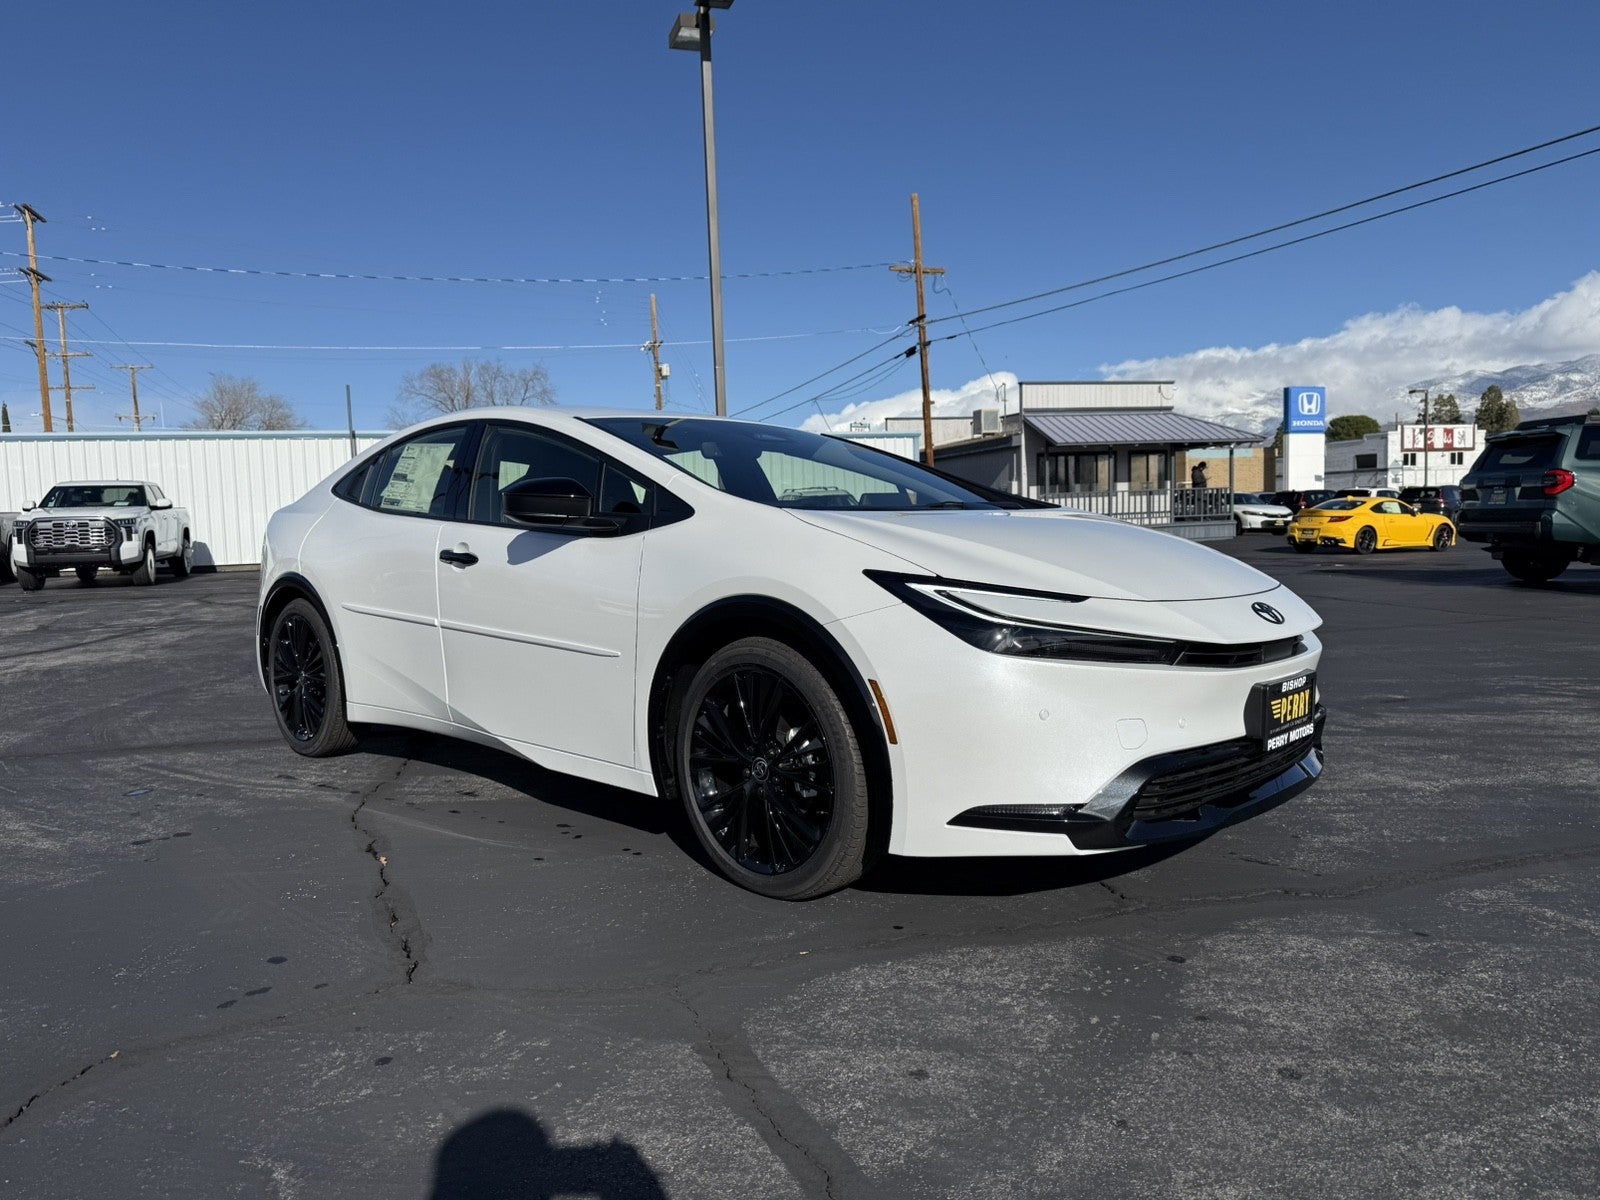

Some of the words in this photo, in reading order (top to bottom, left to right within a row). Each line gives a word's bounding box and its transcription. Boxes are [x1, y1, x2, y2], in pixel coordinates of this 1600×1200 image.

[1281, 676, 1307, 692] BISHOP
[1280, 689, 1310, 724] PERRY
[1267, 733, 1289, 751] PERRY
[1289, 723, 1314, 742] MOTORS
